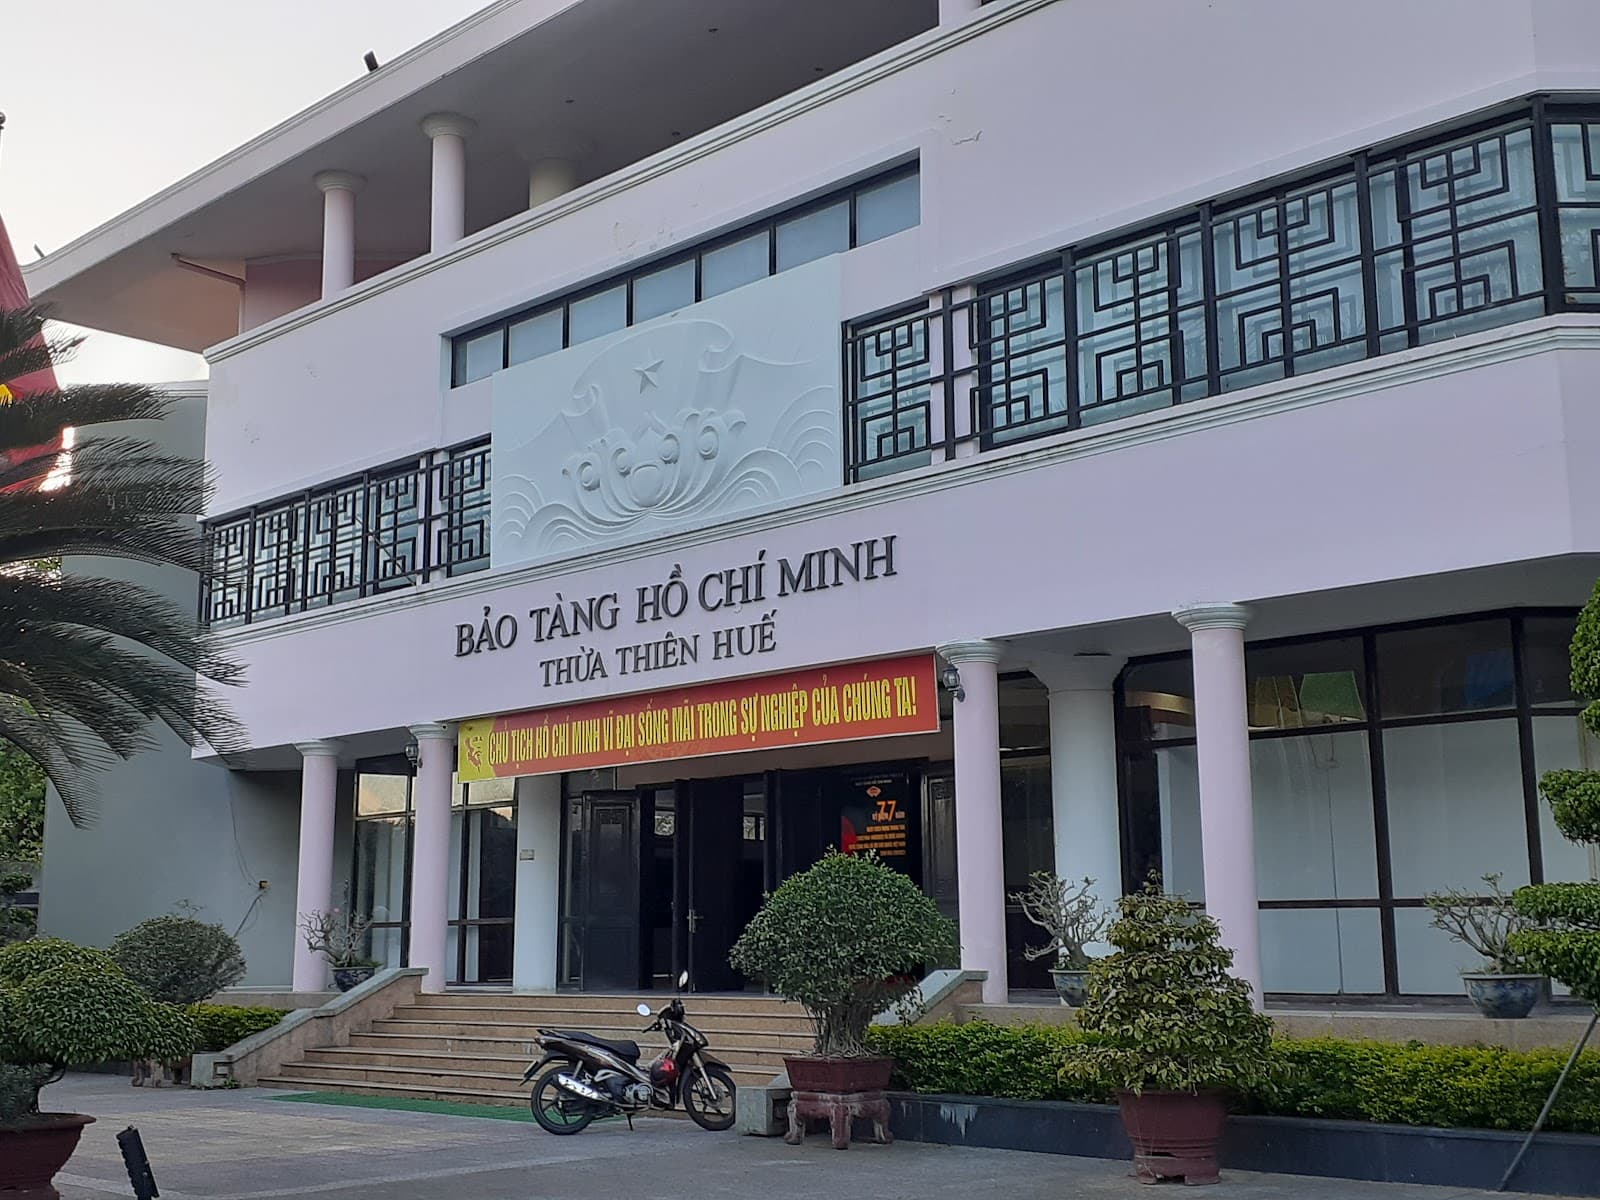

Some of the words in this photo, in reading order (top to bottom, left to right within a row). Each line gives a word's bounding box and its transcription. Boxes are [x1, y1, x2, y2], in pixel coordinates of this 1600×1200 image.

[455, 606, 518, 657] BẢO
[529, 592, 620, 642] TÀNG
[635, 563, 689, 623] HỒ
[698, 549, 766, 611] CHÍ
[777, 535, 897, 597] MINH
[539, 646, 609, 687] THỪA
[615, 630, 701, 675] THIÊN
[712, 609, 778, 660] HUẾ
[489, 720, 509, 765] CHỦ
[511, 727, 533, 769] TỊCH
[536, 713, 550, 760] HỒ
[552, 714, 569, 758] CHÍ
[572, 718, 600, 755] MINH
[603, 710, 614, 751] VĨ
[616, 713, 635, 756] ĐẠI
[638, 698, 669, 747] SỐNG
[672, 698, 695, 743] MÃI
[697, 698, 738, 740] TRONG
[741, 692, 758, 742] SỰ
[761, 682, 808, 737] NGHIỆP
[812, 674, 840, 726] CỦA
[843, 673, 891, 723] CHÚNG
[894, 676, 917, 717] TA!
[876, 799, 897, 822] 77
